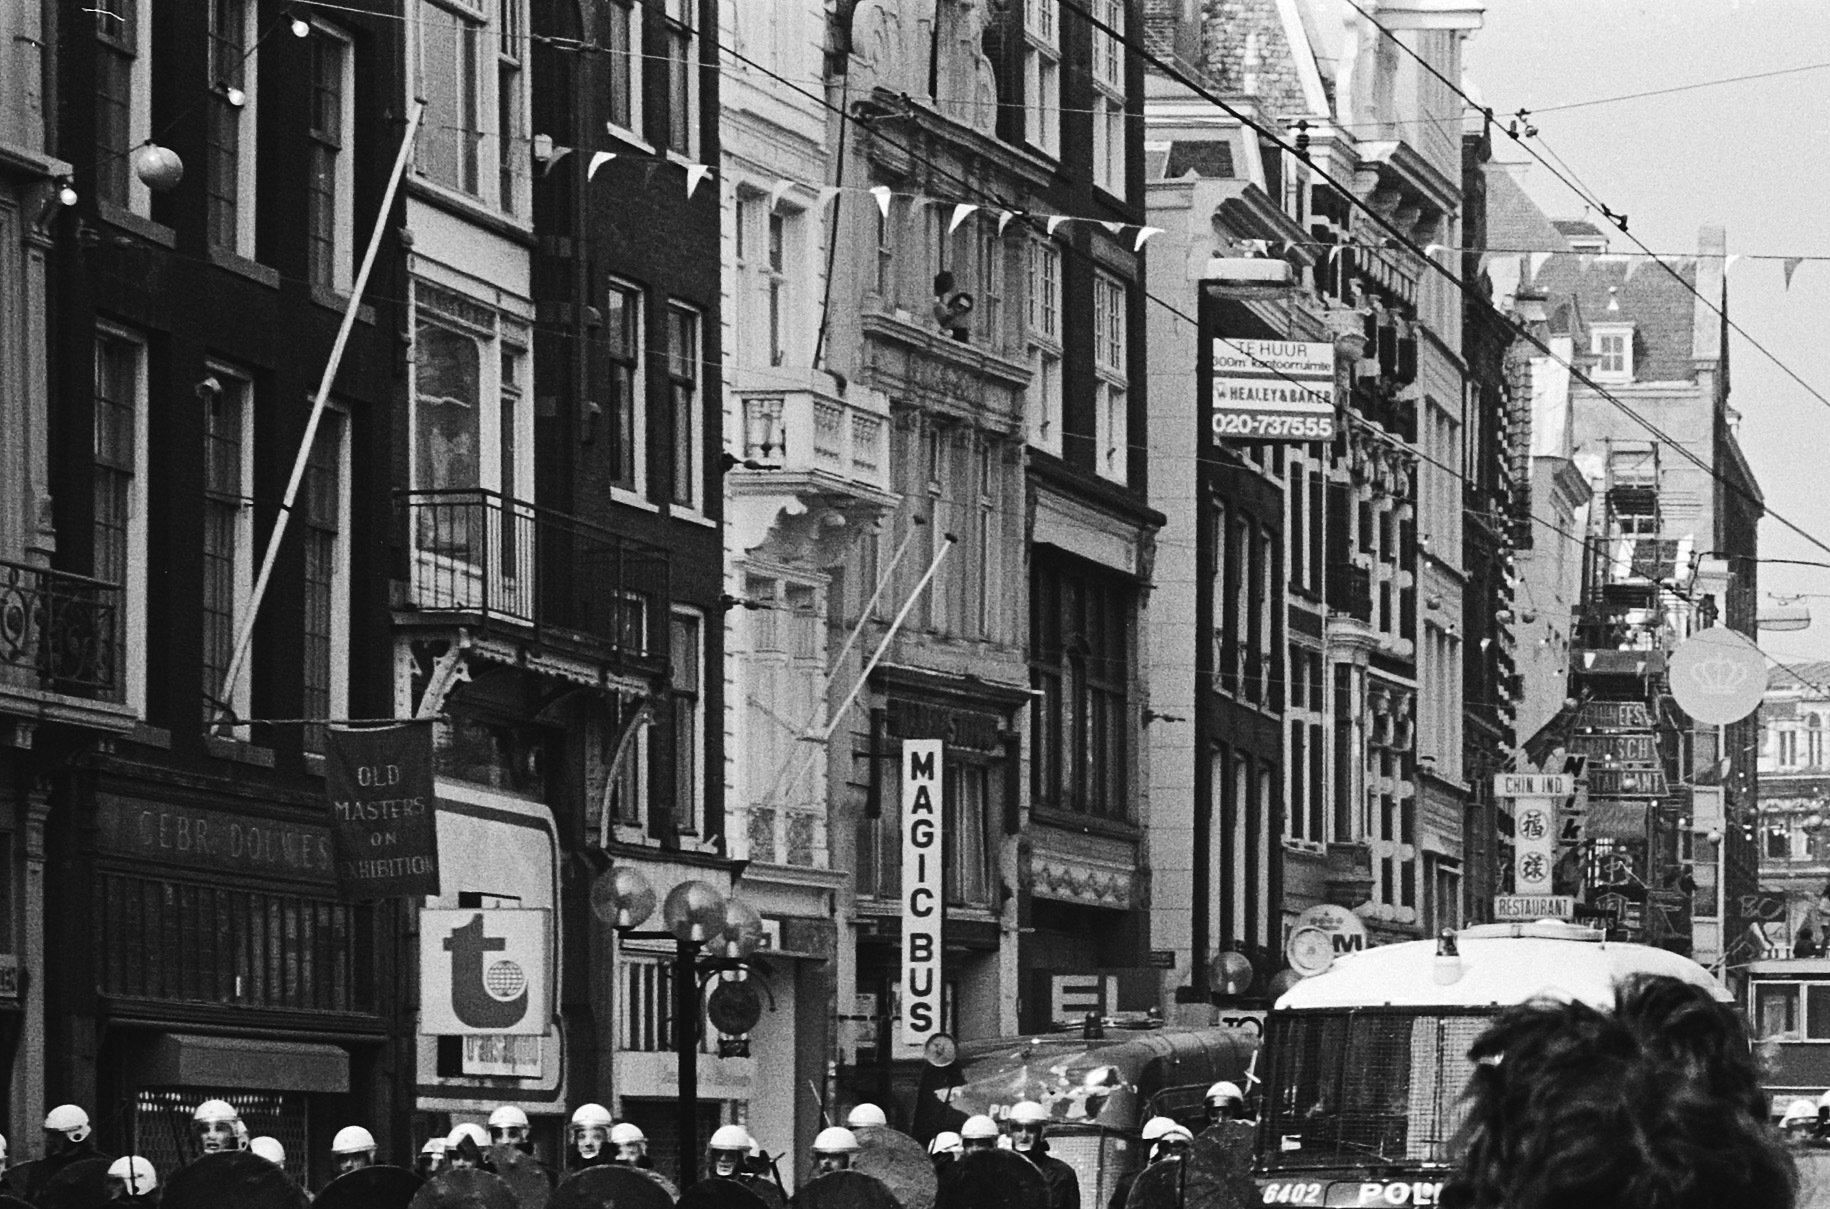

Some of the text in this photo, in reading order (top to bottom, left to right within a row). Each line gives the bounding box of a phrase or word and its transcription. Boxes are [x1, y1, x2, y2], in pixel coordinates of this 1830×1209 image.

[1237, 341, 1308, 357] TE HUUR
[1213, 413, 1333, 437] 020-737555
[358, 765, 400, 787] OLD
[333, 796, 425, 820] MASTERS
[370, 832, 397, 846] ON
[909, 751, 935, 1032] MAGIC BUS
[1498, 898, 1568, 916] RESTAURANT
[1262, 1182, 1322, 1204] 6402
